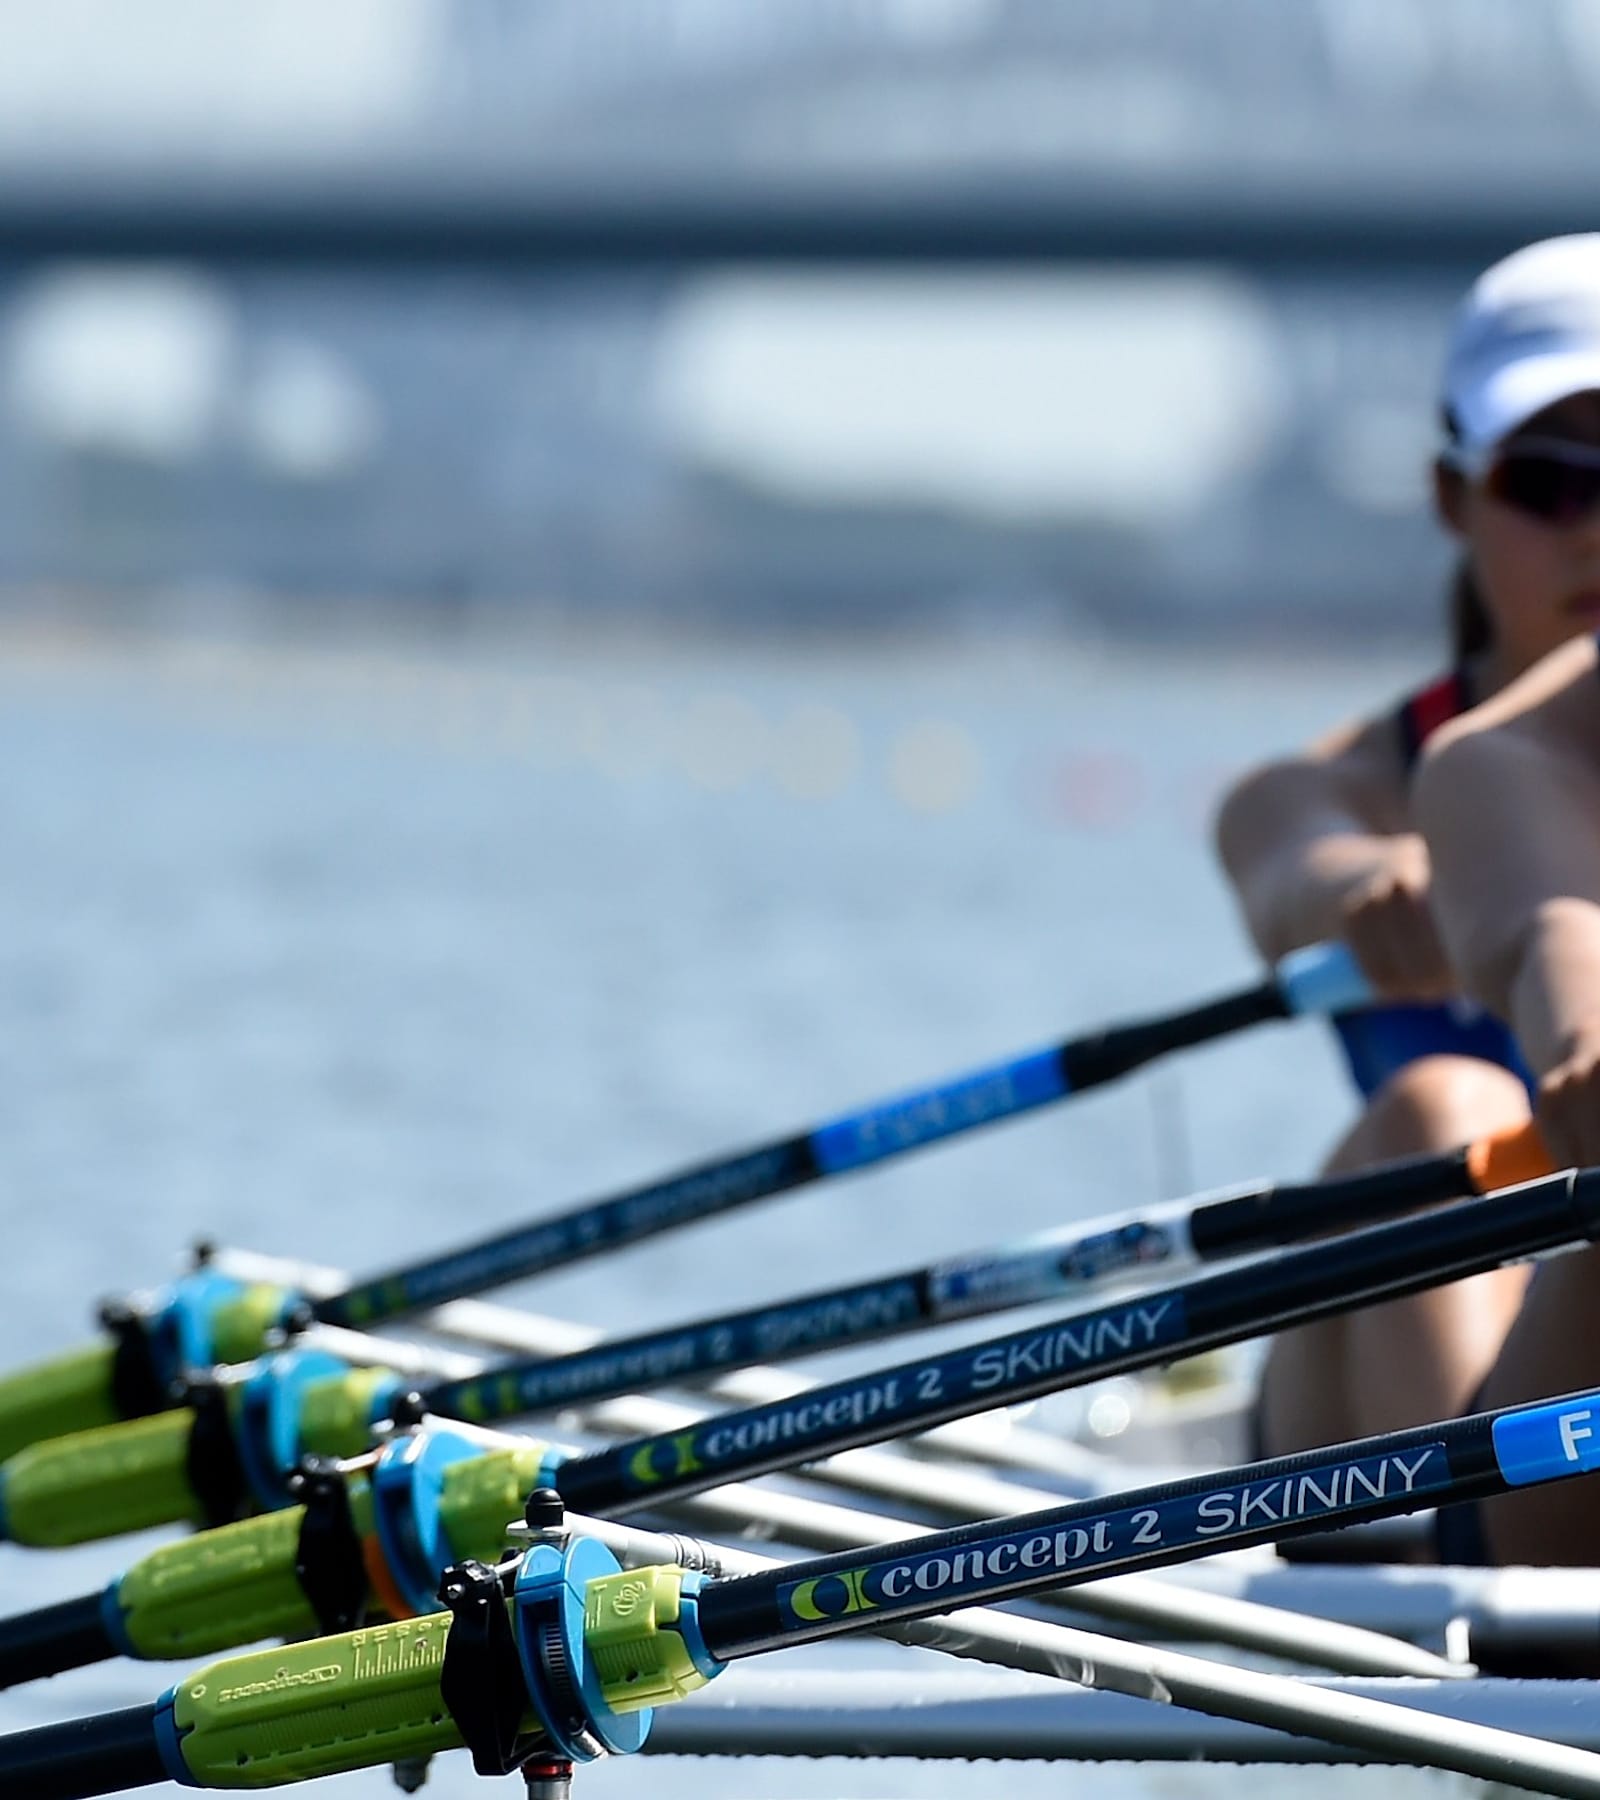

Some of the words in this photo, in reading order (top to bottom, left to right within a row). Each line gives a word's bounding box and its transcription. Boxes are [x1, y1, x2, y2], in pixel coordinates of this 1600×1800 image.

[703, 1378, 901, 1458] concept
[916, 1367, 944, 1400] 2
[970, 1301, 1172, 1389] SKINNY
[880, 1519, 1114, 1598] concept
[1130, 1510, 1162, 1544] 2
[1195, 1450, 1434, 1535] SKINNY
